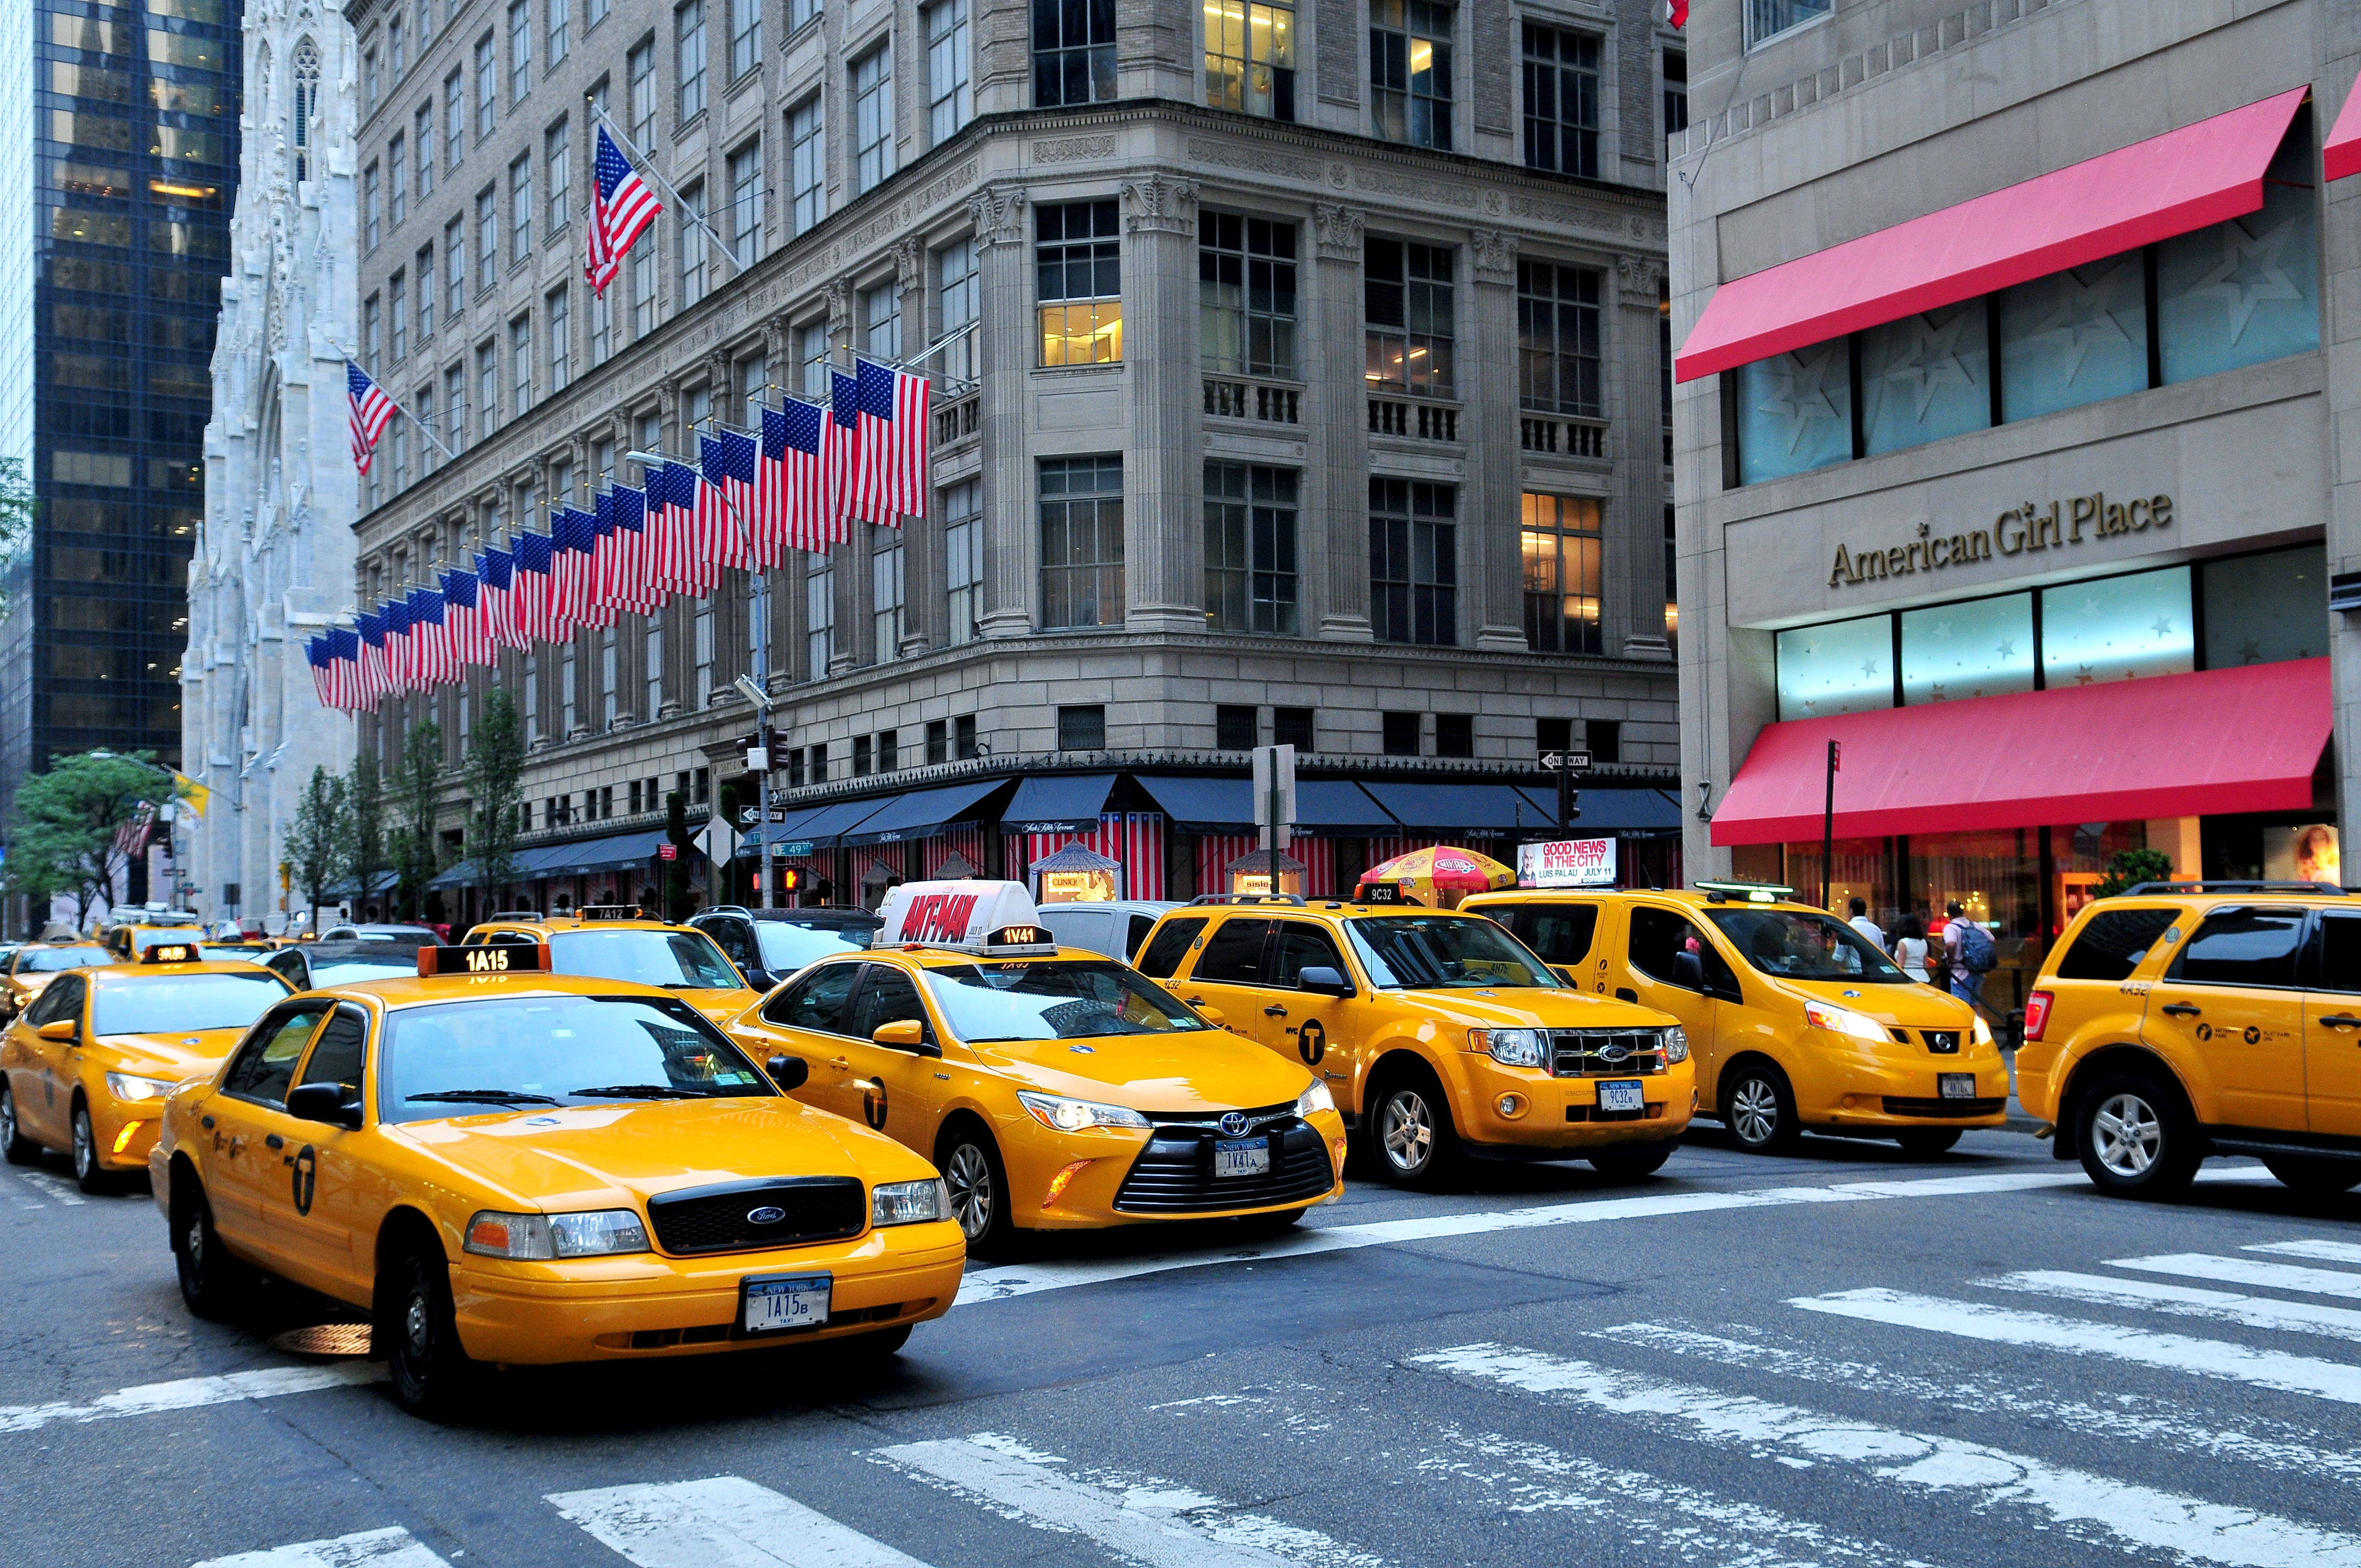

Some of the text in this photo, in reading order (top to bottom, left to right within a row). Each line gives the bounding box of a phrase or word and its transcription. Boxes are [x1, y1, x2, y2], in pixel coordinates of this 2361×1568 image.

[1827, 491, 2172, 586] American Girl Place
[1548, 756, 1585, 765] ONE WAY
[1022, 823, 1040, 832] Saks
[1053, 822, 1075, 832] Avenue
[790, 845, 801, 854] 49
[1543, 840, 1606, 856] GOOD NEWS
[1544, 854, 1604, 868] IN THE CITY
[1539, 867, 1611, 878] LUIS PALAU JULY 11
[1372, 889, 1391, 900] 9C32
[599, 909, 623, 919] 7A12
[899, 894, 978, 944] ANT-MAN
[1004, 928, 1034, 943] 1V41
[466, 950, 508, 971] 1A15
[757, 1211, 777, 1221] Ford
[766, 1283, 808, 1294] NEW YORK
